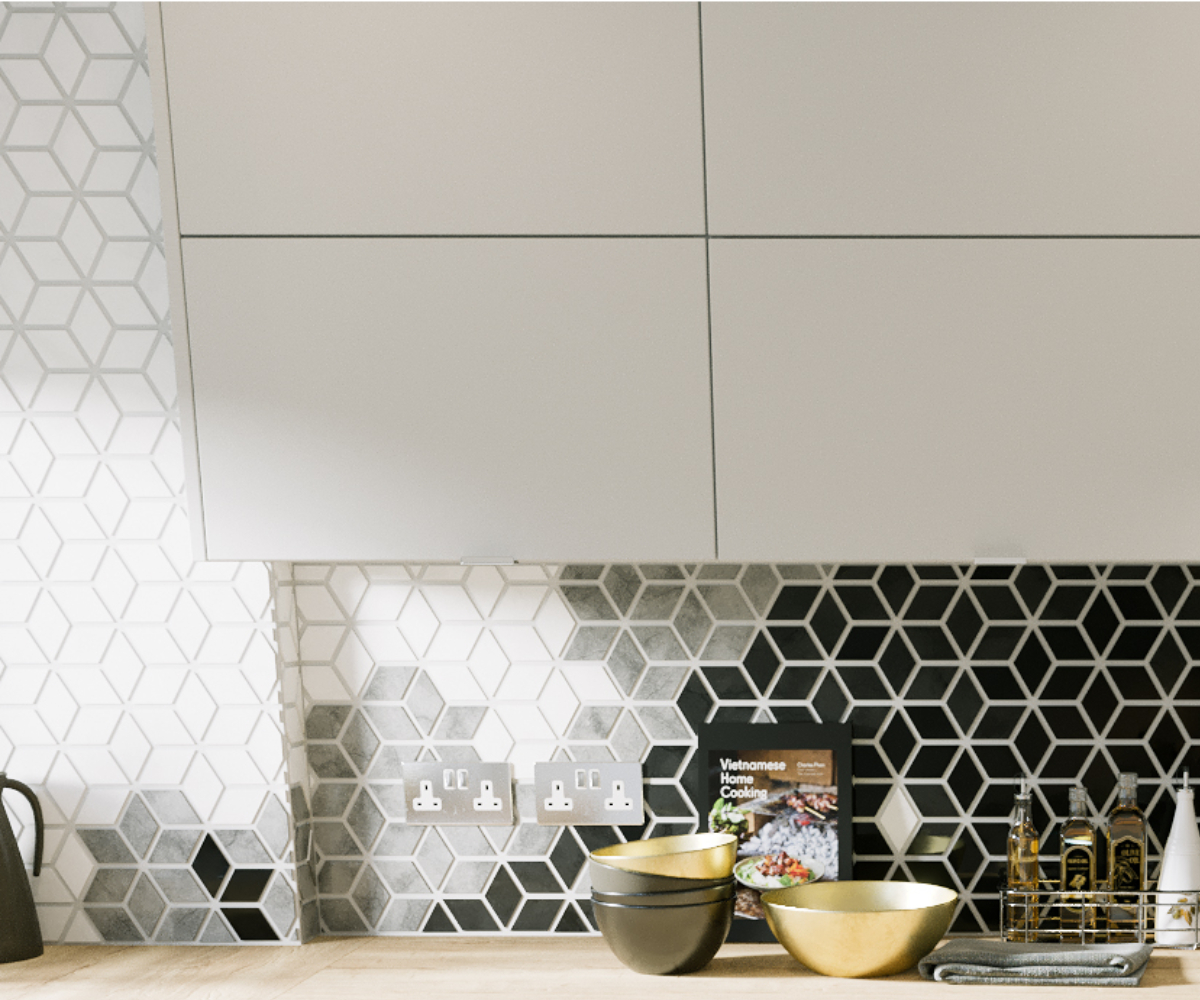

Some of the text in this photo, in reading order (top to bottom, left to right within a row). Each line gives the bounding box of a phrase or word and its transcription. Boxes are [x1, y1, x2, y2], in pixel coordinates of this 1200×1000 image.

[719, 758, 787, 771] Vietnamese
[720, 772, 754, 784] Home
[719, 785, 768, 800] Cooking
